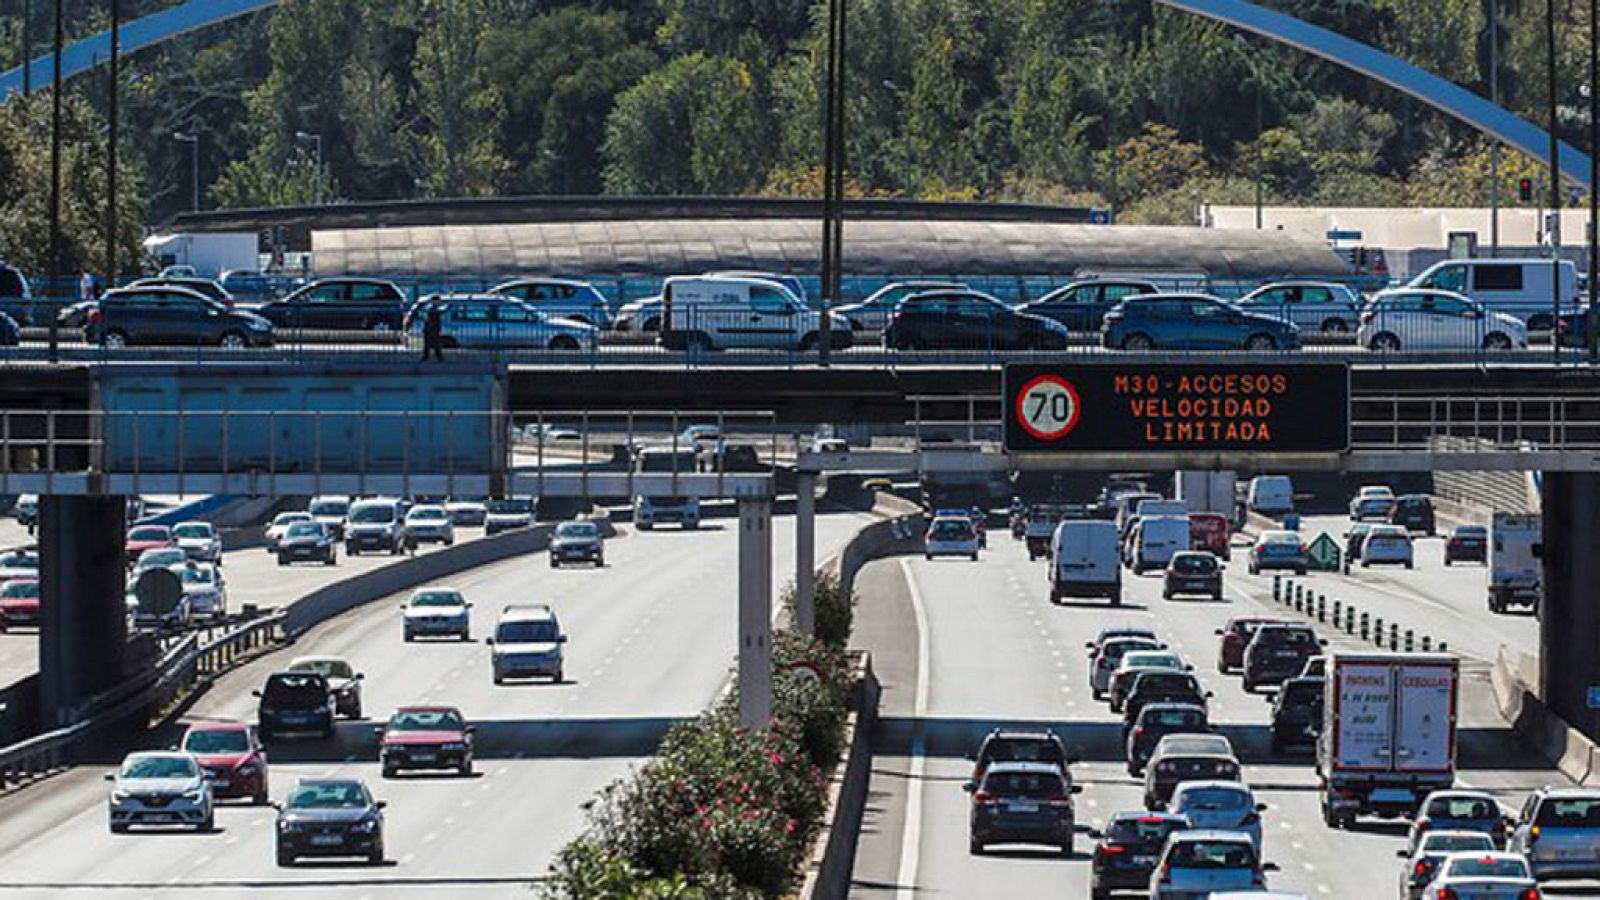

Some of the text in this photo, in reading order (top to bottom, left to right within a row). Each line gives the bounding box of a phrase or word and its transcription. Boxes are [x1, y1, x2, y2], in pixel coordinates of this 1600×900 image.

[1114, 375, 1287, 394] M30-ACCESOS
[1029, 393, 1069, 422] 70
[1130, 398, 1272, 418] VELOCIDAD
[1145, 421, 1271, 441] LIMITADA
